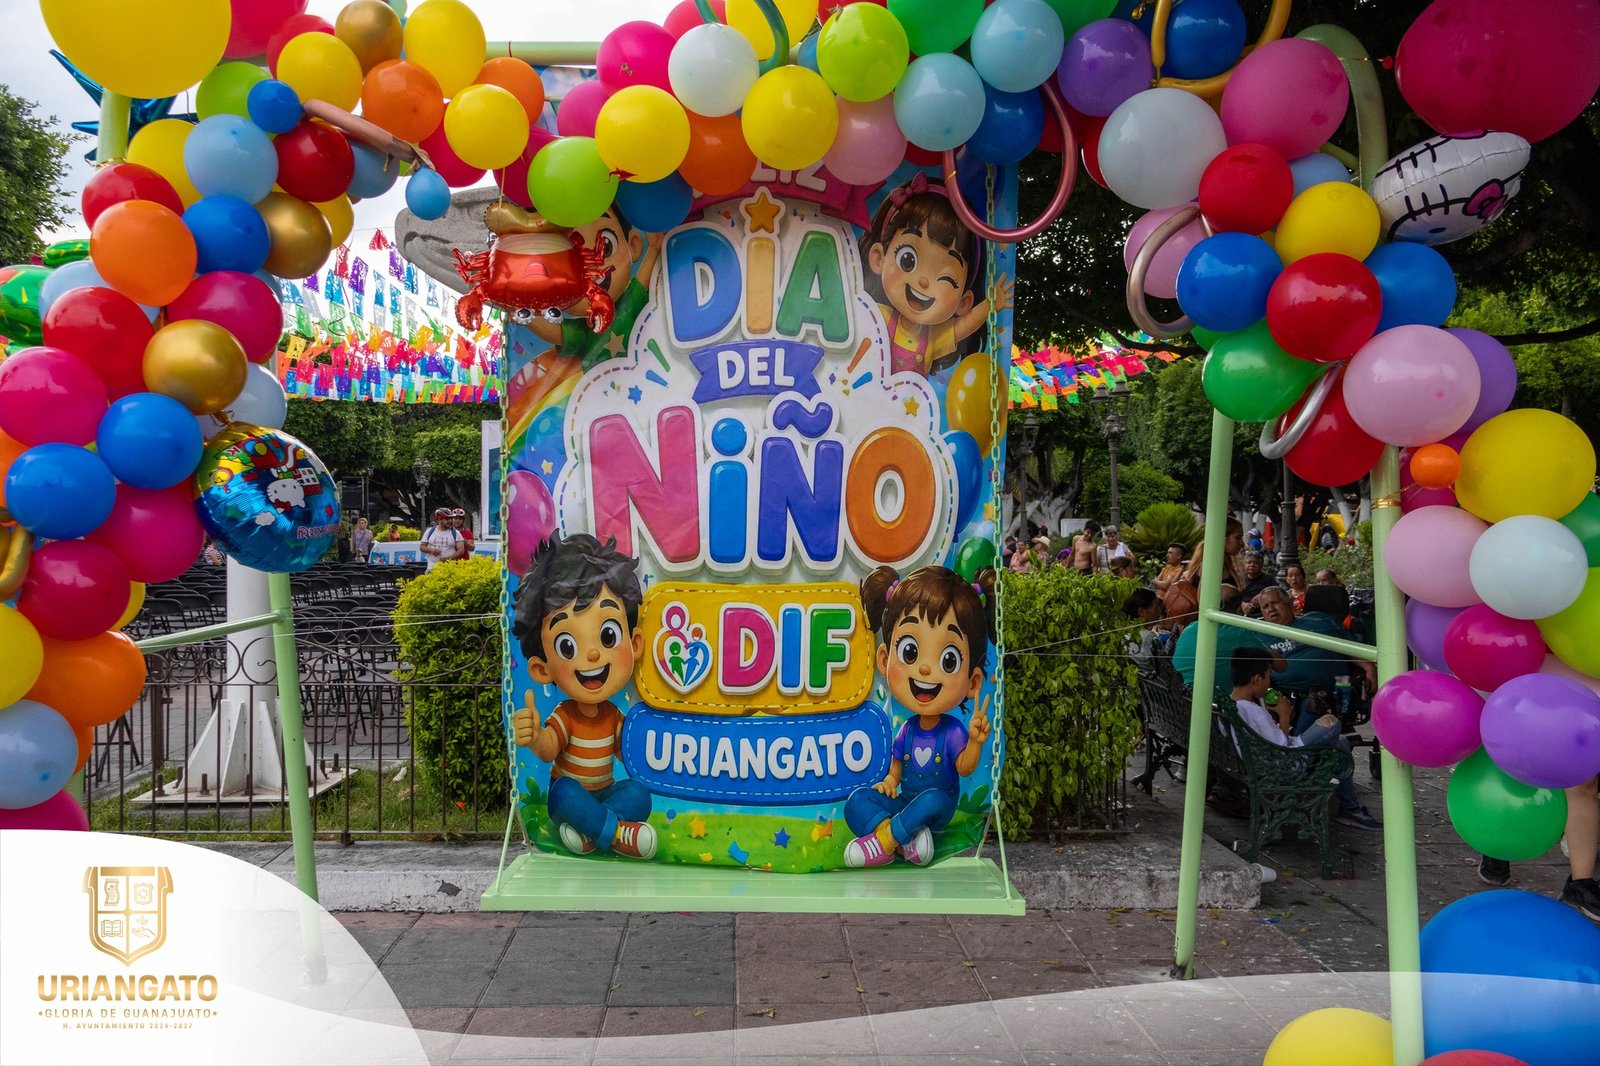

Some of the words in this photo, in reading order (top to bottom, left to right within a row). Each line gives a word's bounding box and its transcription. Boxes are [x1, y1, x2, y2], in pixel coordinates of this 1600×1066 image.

[717, 347, 796, 389] DEL
[717, 602, 856, 694] DIF
[645, 729, 873, 780] URIANGATO
